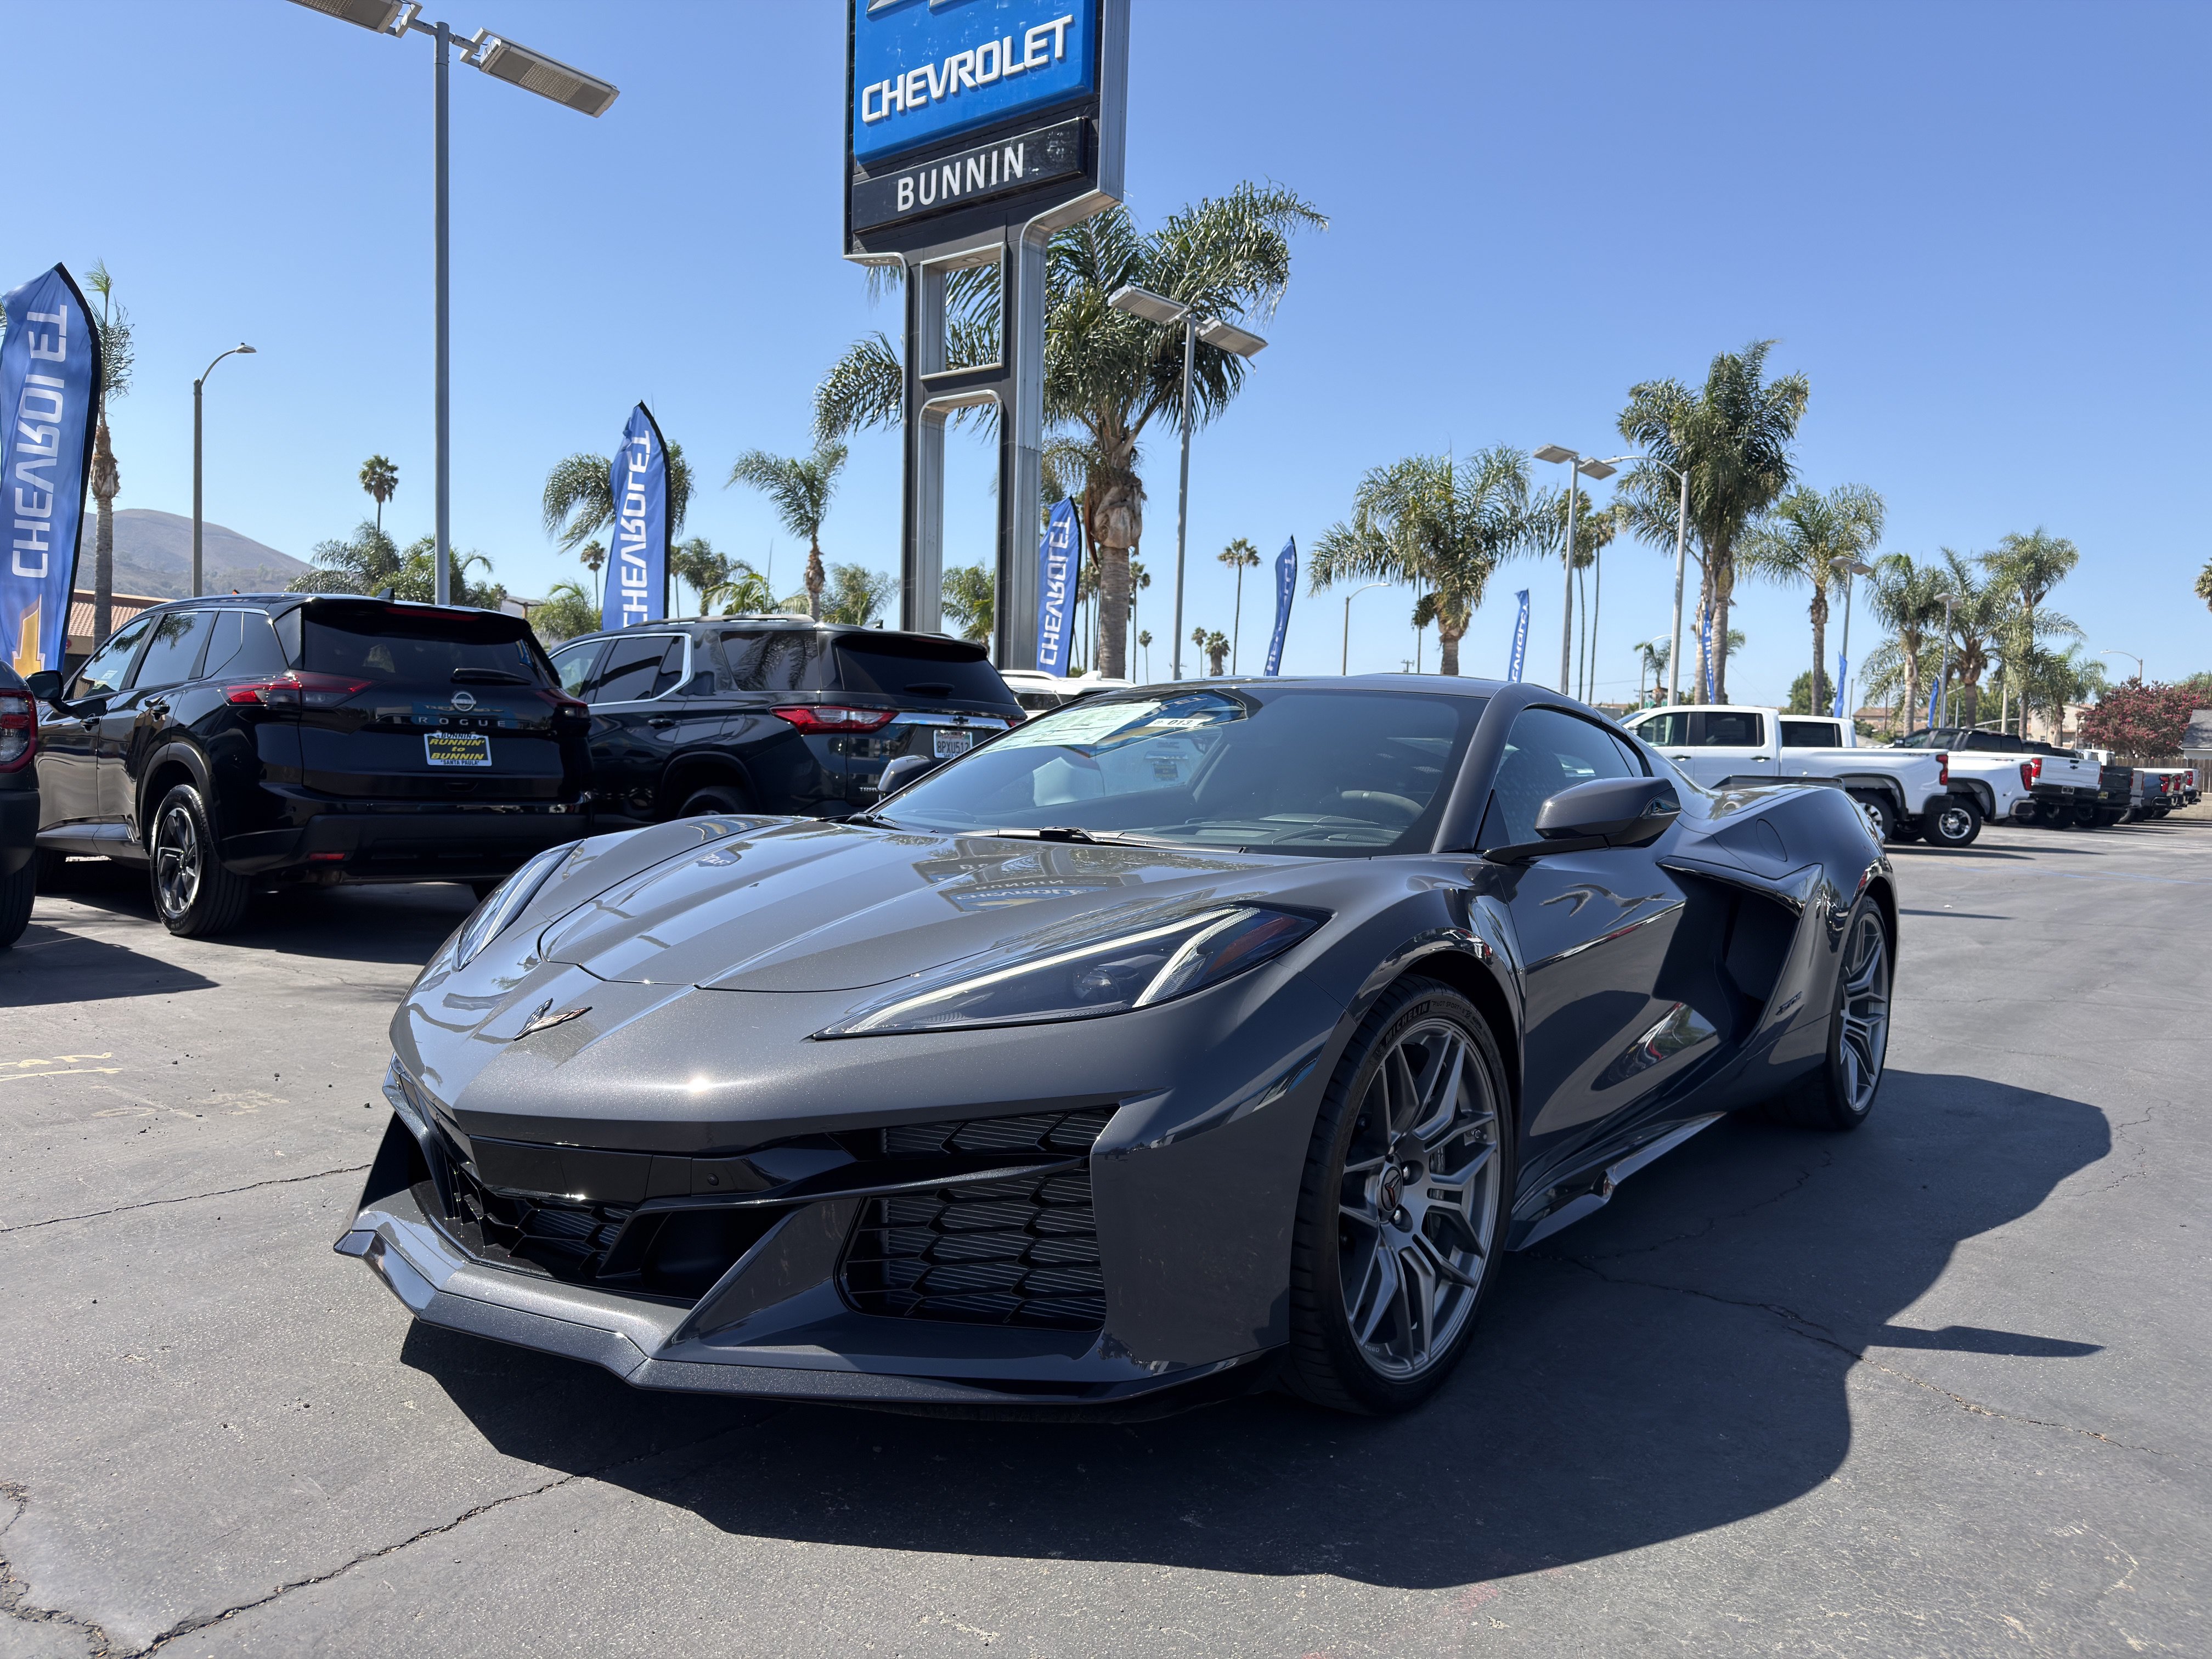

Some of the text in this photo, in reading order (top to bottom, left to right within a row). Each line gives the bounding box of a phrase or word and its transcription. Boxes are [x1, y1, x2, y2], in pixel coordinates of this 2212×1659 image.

[862, 14, 1073, 123] CHEVROLET
[897, 143, 1024, 212] BUNNIN
[418, 716, 505, 727] ROGUE
[937, 741, 969, 754] 8PXU512
[1446, 1001, 1460, 1009] SPORT
[1385, 1002, 1430, 1044] MICHELIN
